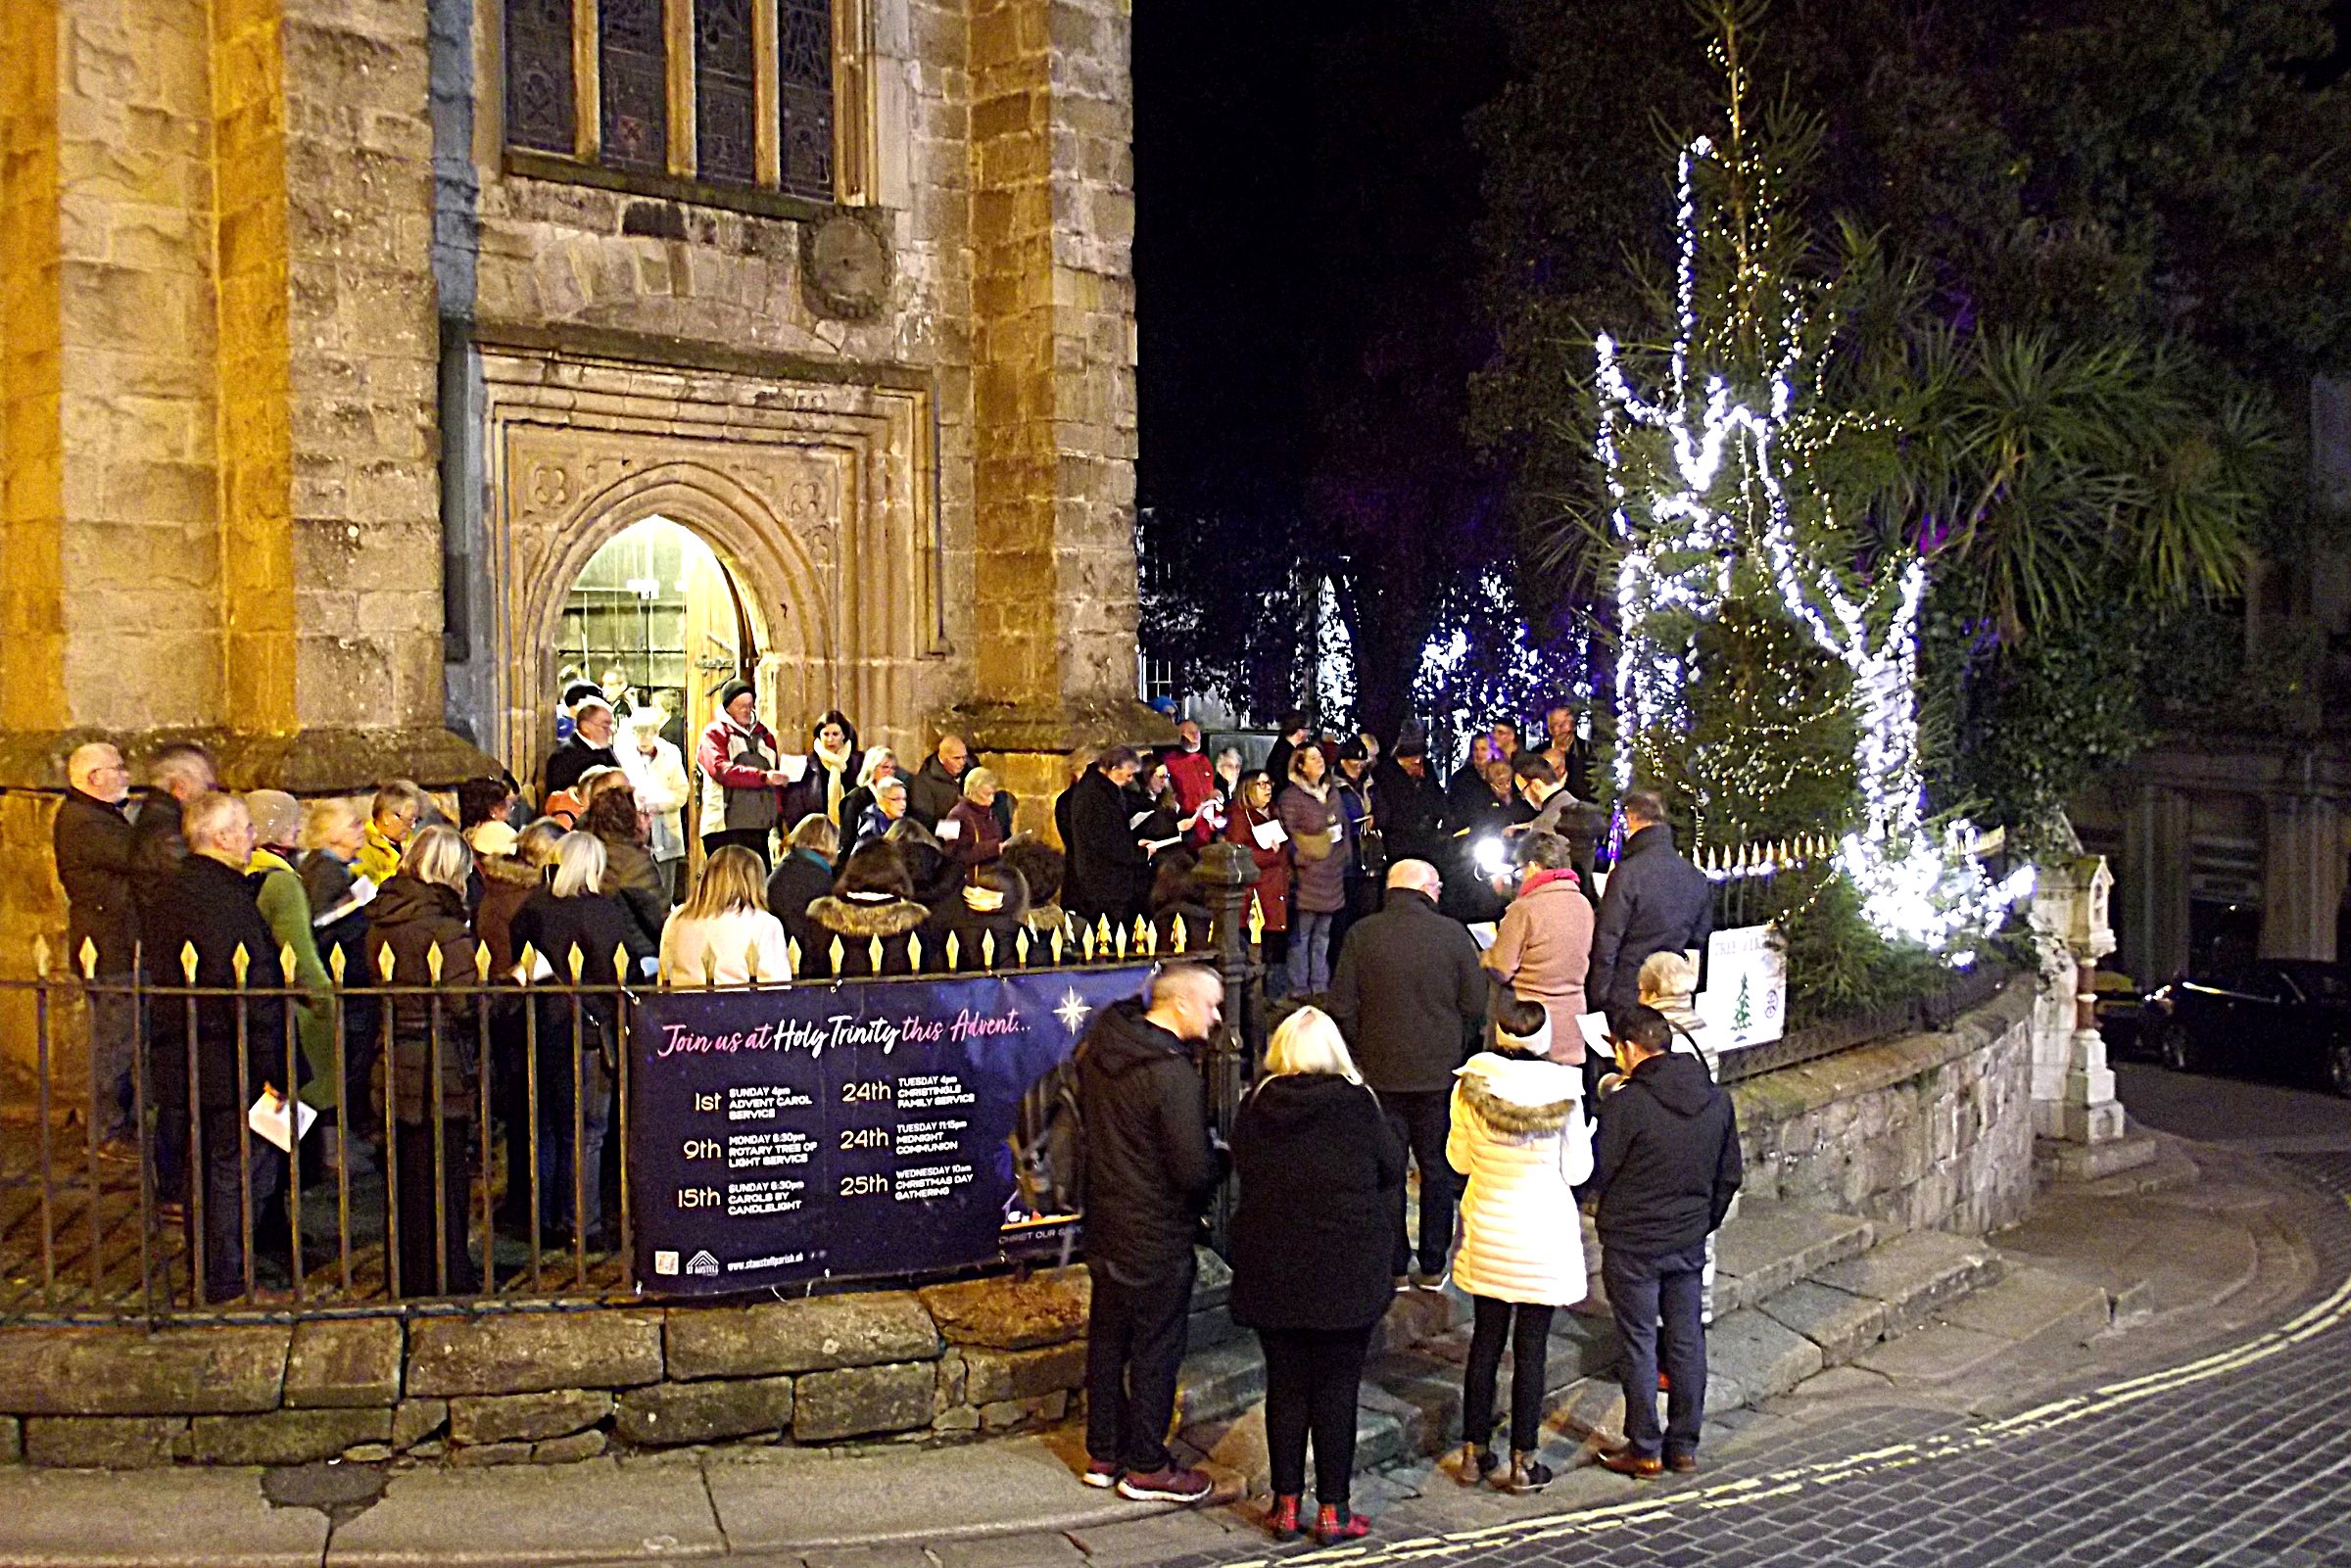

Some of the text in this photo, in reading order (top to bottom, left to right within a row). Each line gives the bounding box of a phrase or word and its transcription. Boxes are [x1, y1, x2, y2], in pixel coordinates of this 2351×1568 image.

[657, 1023, 711, 1058] Join
[715, 1033, 740, 1052] us
[744, 1022, 773, 1050] at
[773, 1018, 828, 1059] Holy
[827, 1014, 902, 1058] Trinity
[901, 1015, 943, 1042] this
[898, 1074, 958, 1088] TUESDAY 4pm
[729, 1085, 792, 1099] SUNDAY 4pm
[842, 1079, 891, 1103] 24th
[897, 1083, 961, 1098] CHRISTINGLE
[695, 1092, 722, 1111] 1st
[729, 1095, 813, 1110] ADVENT CAROL
[897, 1093, 976, 1109] FAMILY SERVICE
[729, 1108, 776, 1120] SERVICE
[896, 1121, 937, 1134] TUESDAY
[729, 1133, 771, 1146] MONDAY
[840, 1125, 889, 1150] 24th
[896, 1131, 944, 1144] MIDNIGHT
[683, 1137, 722, 1160] 9th
[729, 1141, 818, 1157] ROTARY TREE OF
[895, 1141, 958, 1155] COMMUNION
[728, 1153, 808, 1168] LIGHT SERVICE
[895, 1164, 972, 1179] WEDNESDAY 10am
[728, 1181, 770, 1194] SUNDAY
[840, 1173, 888, 1196] 25th
[895, 1173, 974, 1190] CHRISTMAS DAY
[678, 1186, 721, 1208] 15th
[728, 1191, 790, 1205] CAROLS BY
[894, 1187, 950, 1201] GATHERING
[727, 1200, 802, 1215] CANDLELIGHT
